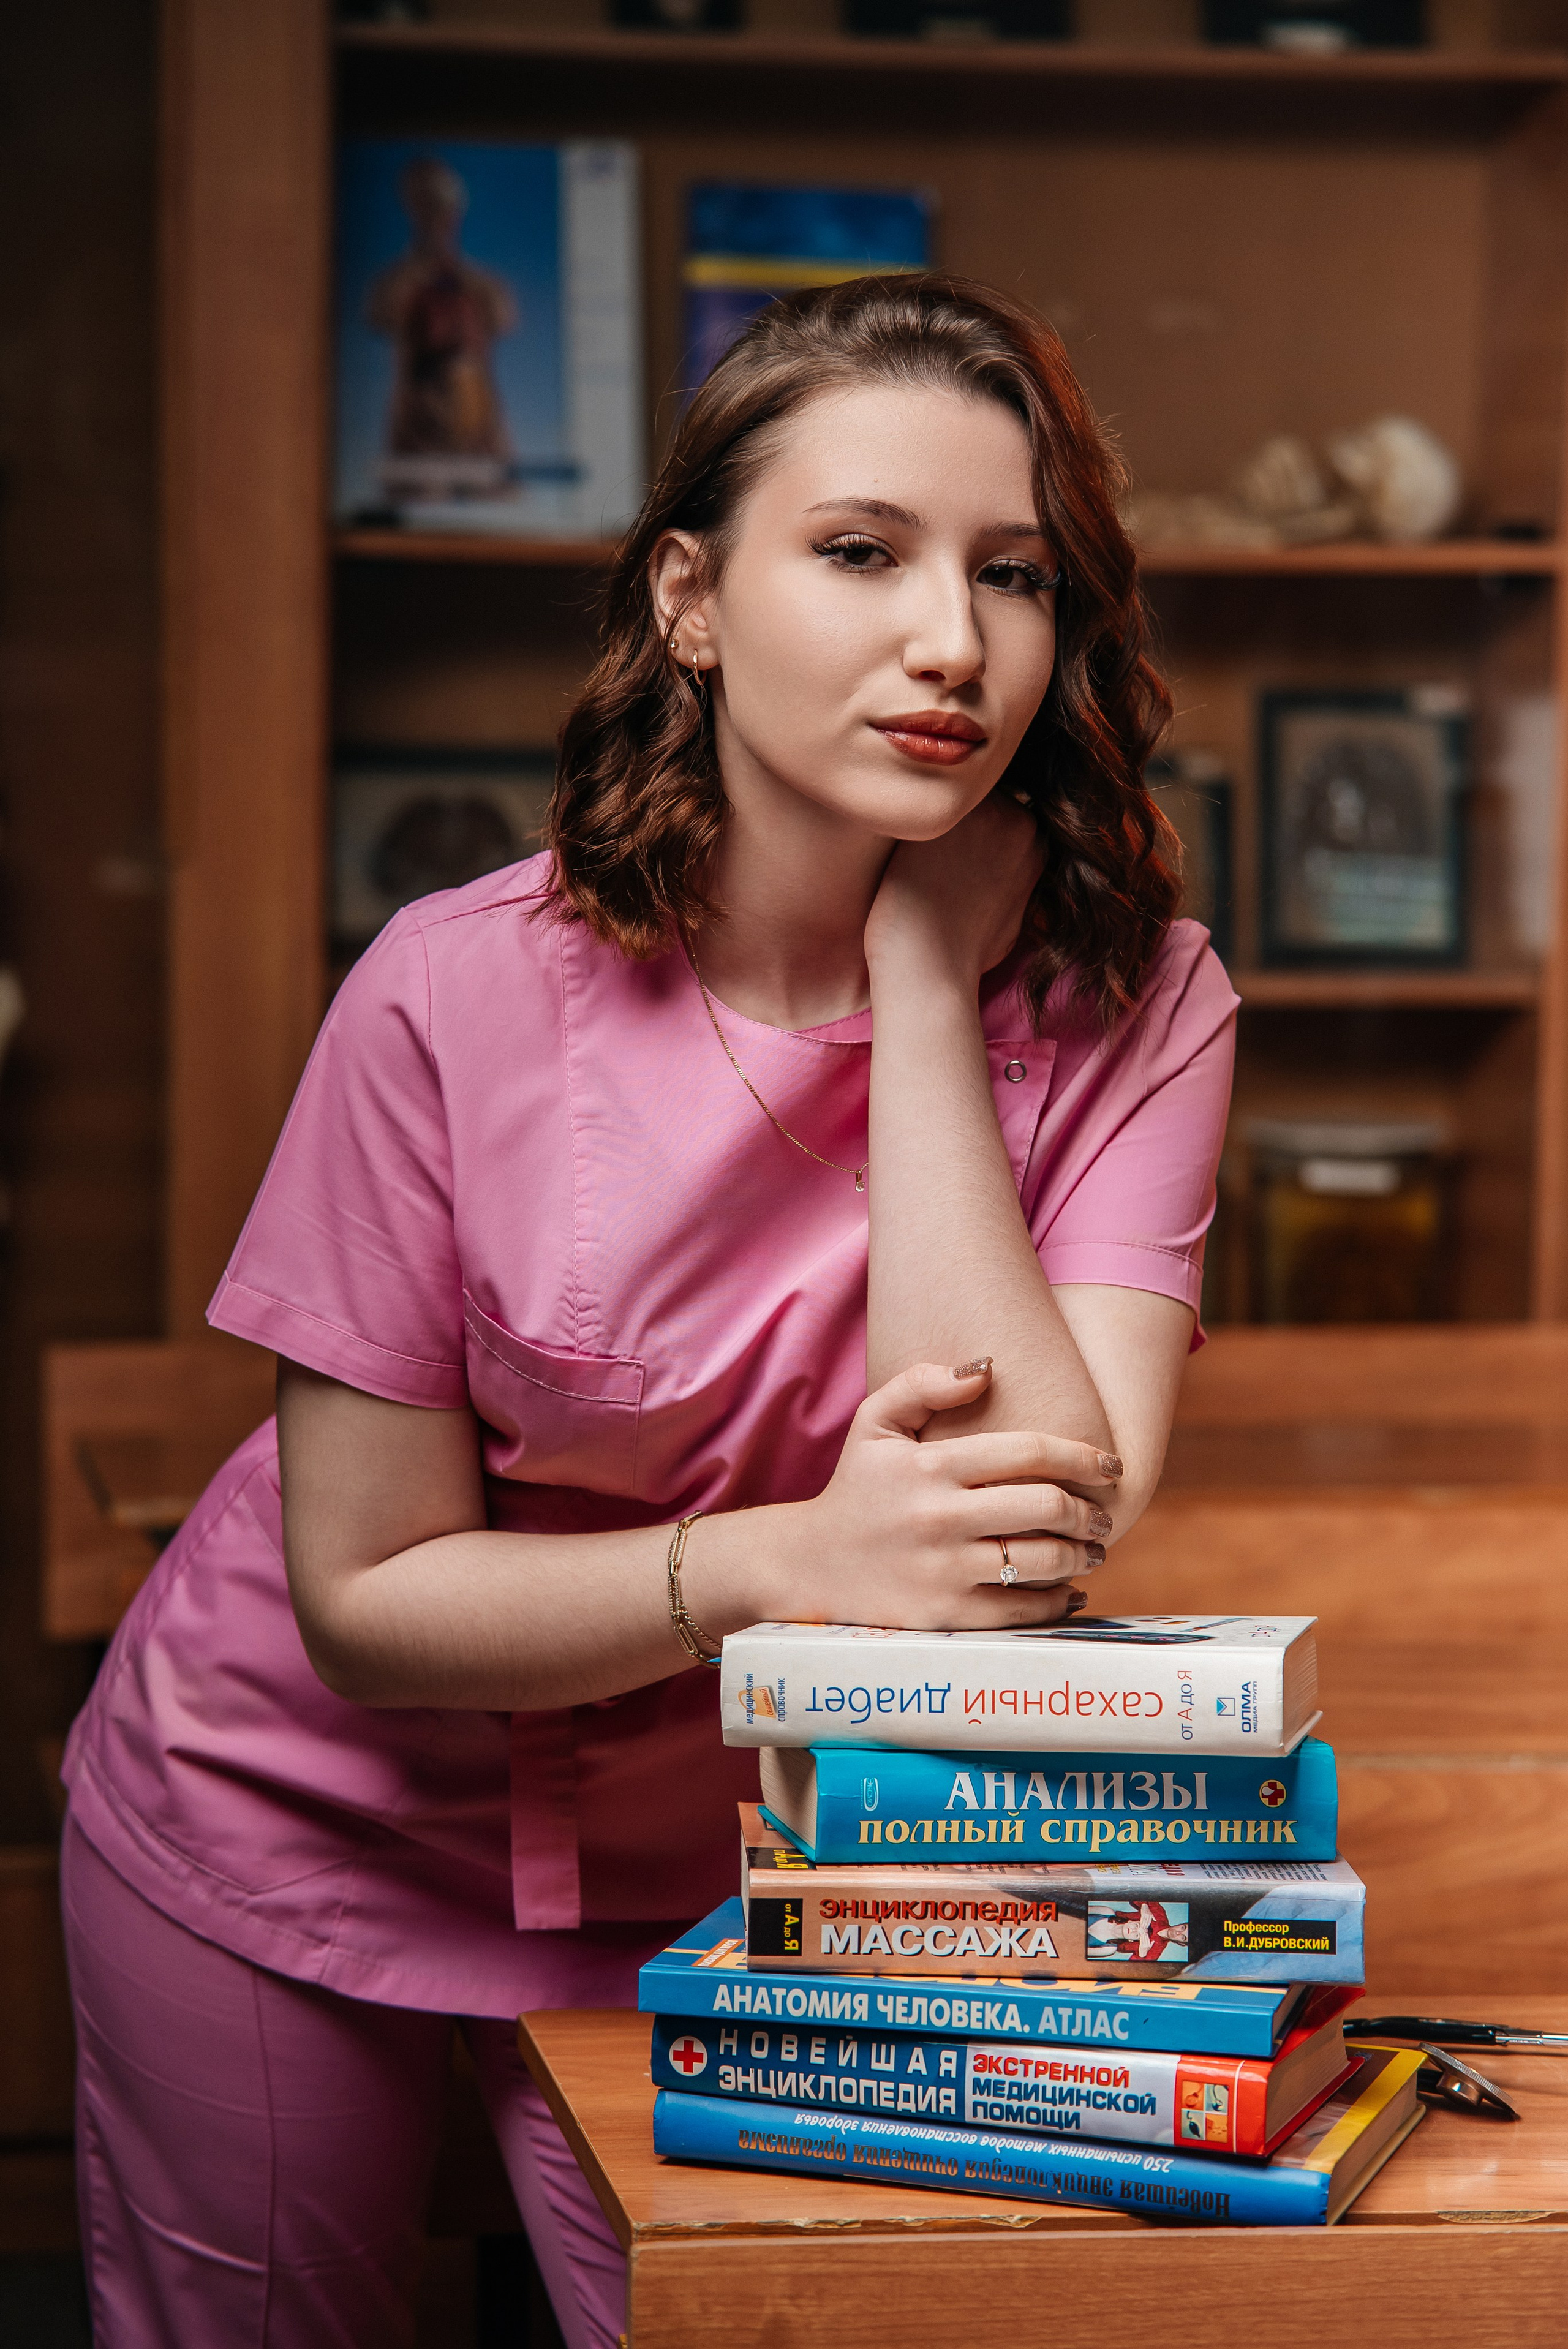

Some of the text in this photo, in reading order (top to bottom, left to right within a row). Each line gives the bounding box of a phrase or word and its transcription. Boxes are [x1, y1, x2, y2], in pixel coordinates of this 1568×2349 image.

[1177, 1670, 1193, 1680] Я
[744, 1673, 755, 1724] медицинский
[777, 1678, 788, 1722] справочник
[805, 1680, 1163, 1725] сахарный диабет
[1177, 1708, 1193, 1721] А
[1241, 1681, 1251, 1733] ОЛМА
[944, 1771, 1209, 1811] АНАЛИЗЫ
[858, 1811, 1298, 1853] полный справочник
[785, 1914, 800, 1925] А
[1224, 1920, 1289, 1935] Профессор
[784, 1940, 799, 1950] Я
[821, 1924, 1059, 1958] МАССАЖА
[1223, 1936, 1330, 1950] В.И.ДУБРОВСКИЙ
[712, 1984, 869, 2021] АНАТОМИЯ
[876, 1994, 1030, 2033] ЧЕЛОВЕКА.
[1038, 2005, 1129, 2041] АТЛАС
[973, 2053, 1130, 2089] ЭКСТРЕННОЙ
[718, 2065, 957, 2115] ЭНЦИКЛОПЕДИЯ
[972, 2077, 1156, 2116] МЕДИЦИНСКОЙ
[972, 2100, 1081, 2130] ПОМОЩИ
[737, 2129, 847, 2162] организма
[794, 2113, 1174, 2173] 250 испытанных методов восстановления здоровья
[852, 2144, 958, 2177] очищения
[964, 2158, 1113, 2195] энциклопедия
